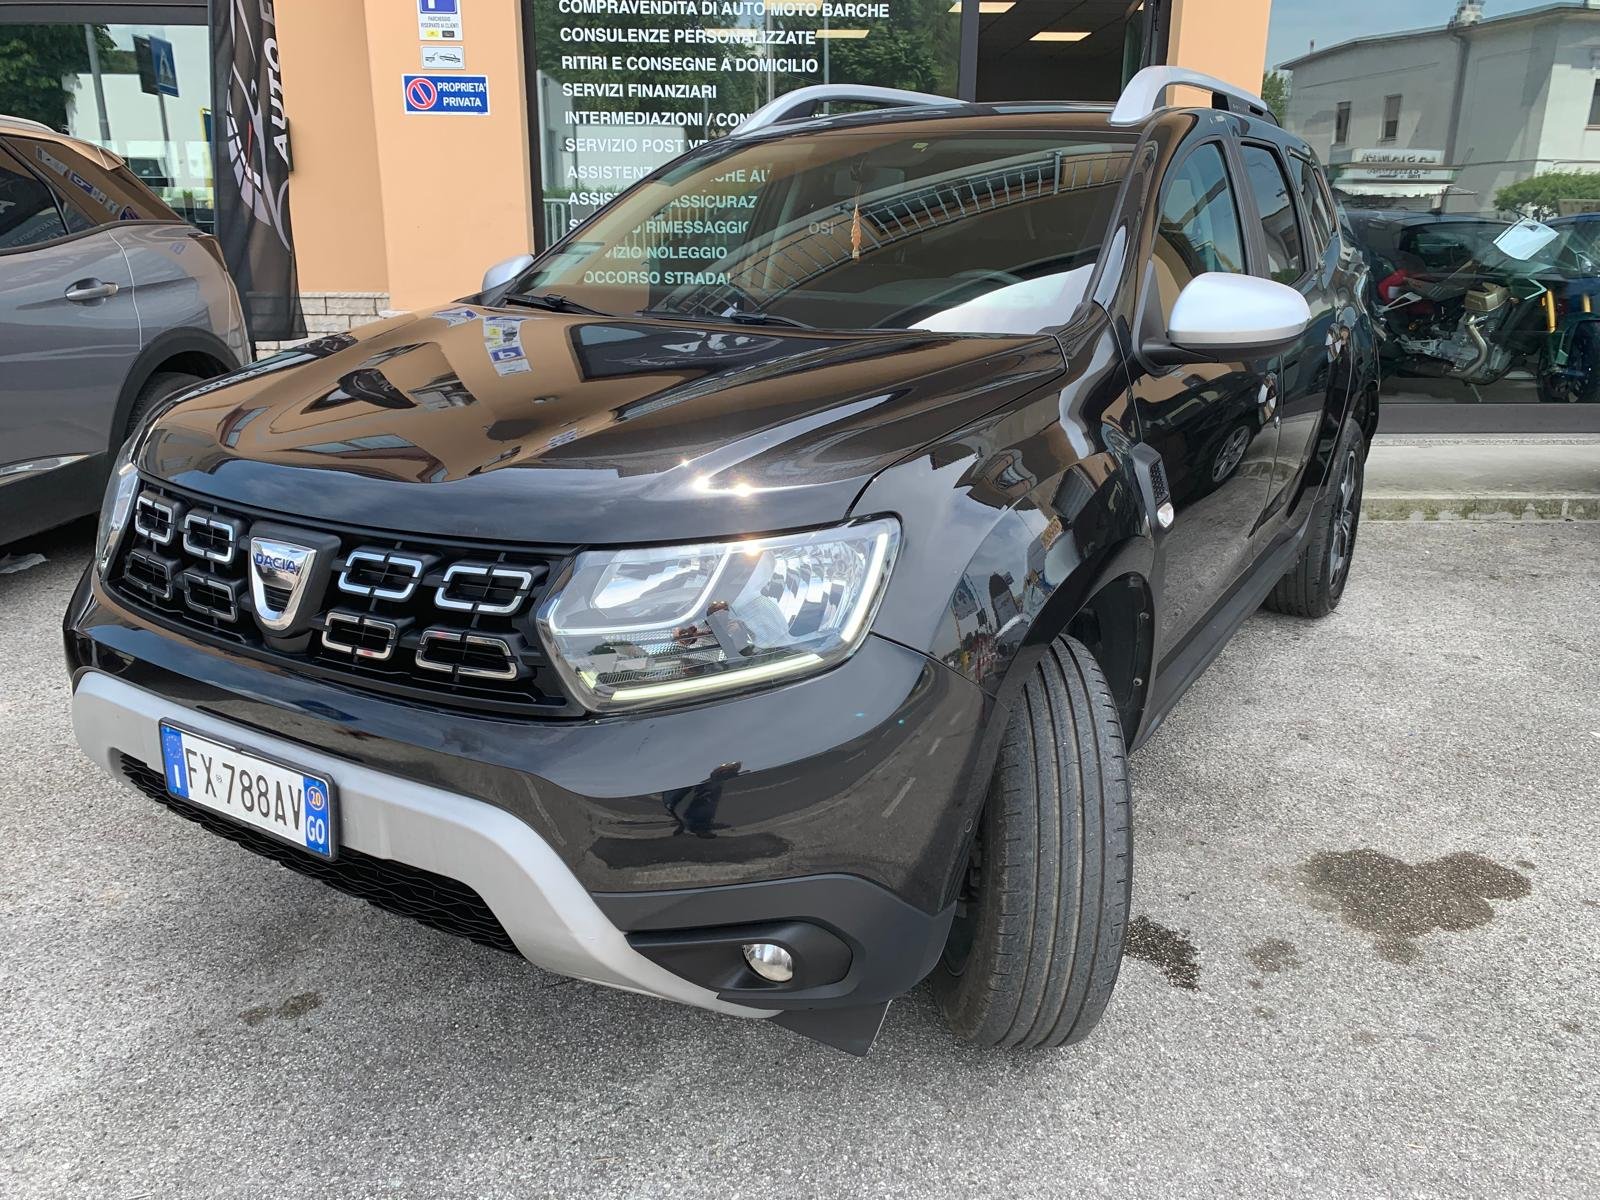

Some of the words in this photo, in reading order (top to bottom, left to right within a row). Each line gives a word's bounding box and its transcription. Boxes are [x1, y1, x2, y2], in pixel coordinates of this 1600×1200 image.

[558, 0, 698, 15] COMPRAVENDITA
[701, 3, 717, 15] DI
[720, 2, 766, 16] AUTO
[770, 3, 818, 16] MOTO
[822, 4, 890, 17] BARCHE
[560, 28, 670, 42] CONSULENZE
[674, 29, 816, 45] PERSONALIZZATE
[561, 56, 607, 70] RITIRI
[612, 57, 622, 70] E
[626, 57, 717, 72] CONSEGNE
[720, 59, 732, 71] A
[735, 58, 818, 73] DOMICILIO
[562, 83, 624, 97] SERVIZI
[628, 84, 717, 99] FINANZIARI
[263, 37, 290, 166] AUTO
[443, 97, 482, 107] PRIVATA
[565, 111, 703, 126] INTERMEDIAZIONI
[716, 113, 752, 127] CON
[565, 138, 638, 152] SERVIZIO
[642, 139, 684, 153] POST
[567, 165, 654, 179] ASSISTENZ
[568, 192, 619, 206] ASSIS
[670, 195, 758, 208] ASSICURAZ
[647, 246, 728, 259] NOLEGGIO
[583, 271, 661, 284] OCCORSO
[254, 552, 297, 573] DACIA
[184, 747, 302, 830] FX788AV
[306, 815, 325, 845] GO
